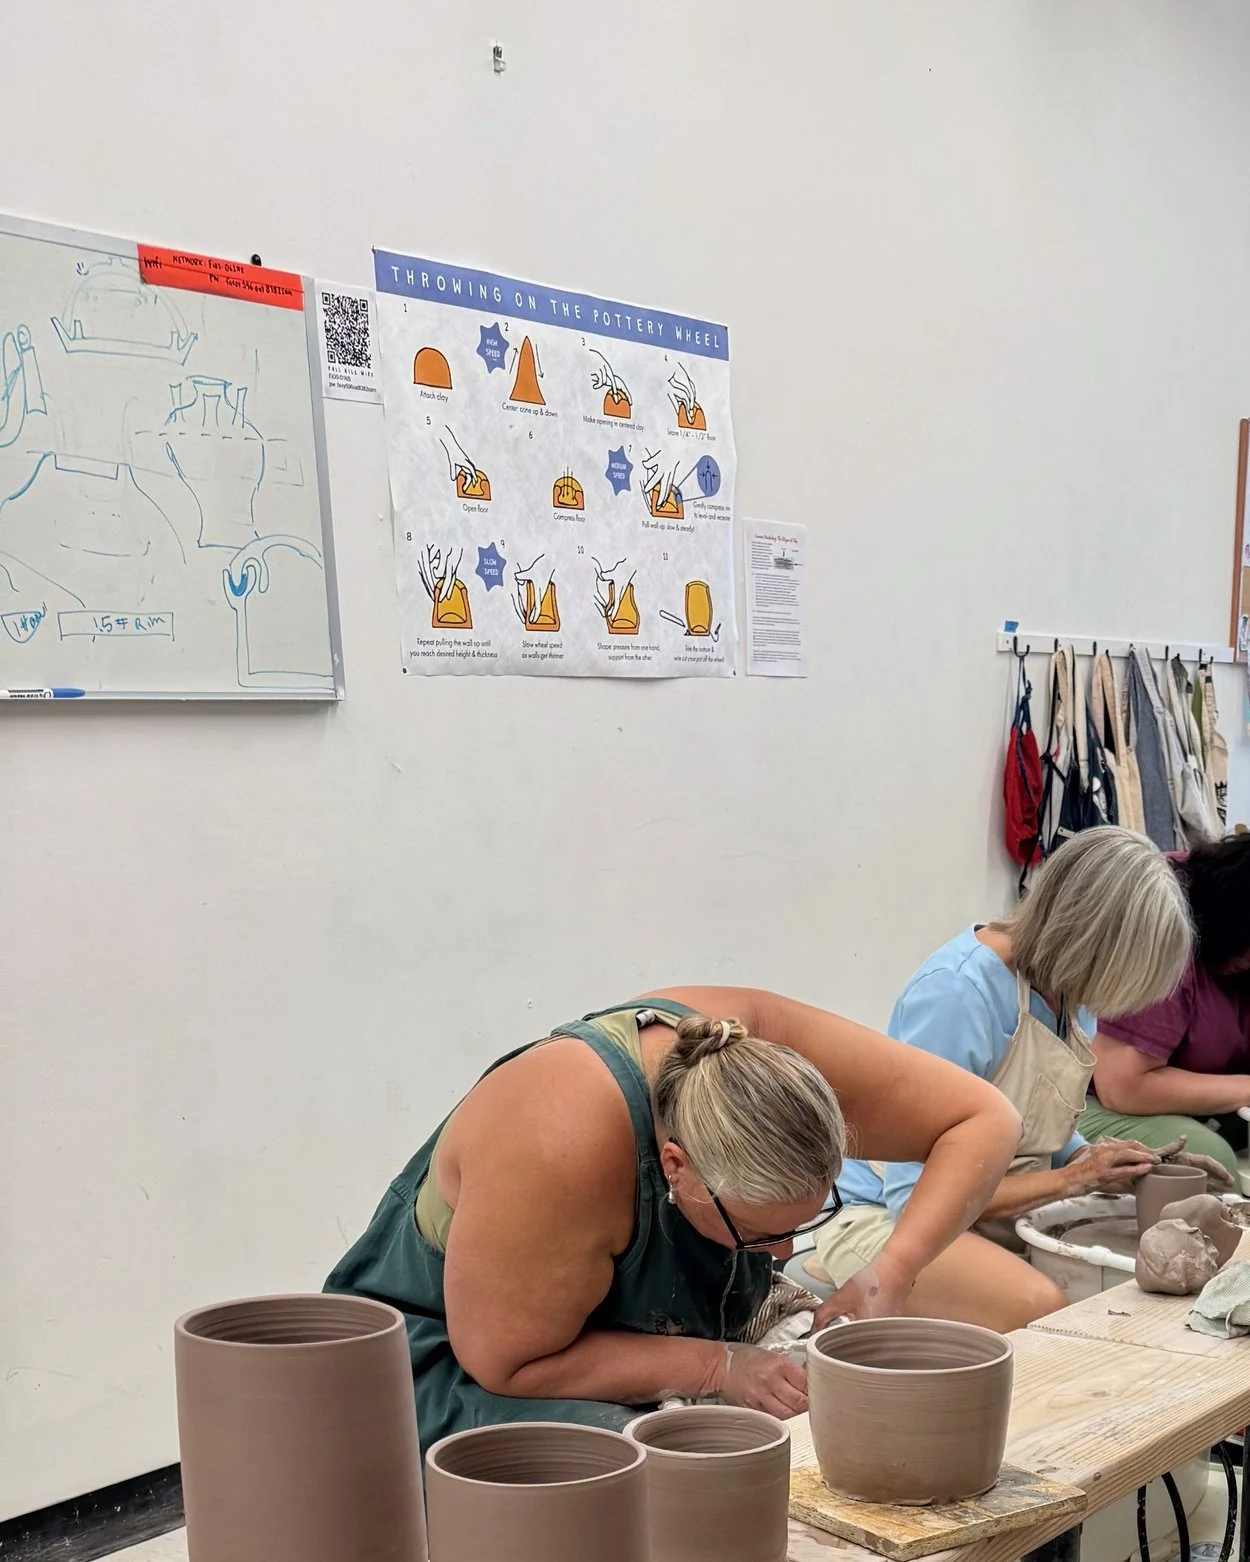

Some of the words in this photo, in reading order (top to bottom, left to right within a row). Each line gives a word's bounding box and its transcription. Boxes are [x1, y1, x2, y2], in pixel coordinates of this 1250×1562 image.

[391, 266, 502, 303] THROWING
[515, 292, 536, 310] ON
[550, 299, 581, 319] THE
[593, 309, 664, 336] POTTERY
[675, 326, 719, 349] WHEEL
[486, 349, 500, 358] SPEED
[420, 390, 436, 400] Attach
[436, 393, 449, 402] clay
[532, 408, 538, 416] up
[426, 416, 431, 425] 5
[529, 430, 533, 439] 6
[462, 503, 477, 514] Open
[553, 512, 575, 522] Compress
[406, 532, 412, 541] 8
[500, 540, 505, 548] 9
[577, 545, 584, 554] 10
[663, 552, 668, 561] 11
[483, 558, 497, 566] SLOW
[483, 568, 499, 576] SPEED
[416, 638, 434, 648] Repeat
[435, 639, 453, 649] pulling
[422, 649, 435, 657] reach
[436, 649, 454, 658] desired
[455, 649, 471, 660] height
[476, 650, 498, 658] thickness
